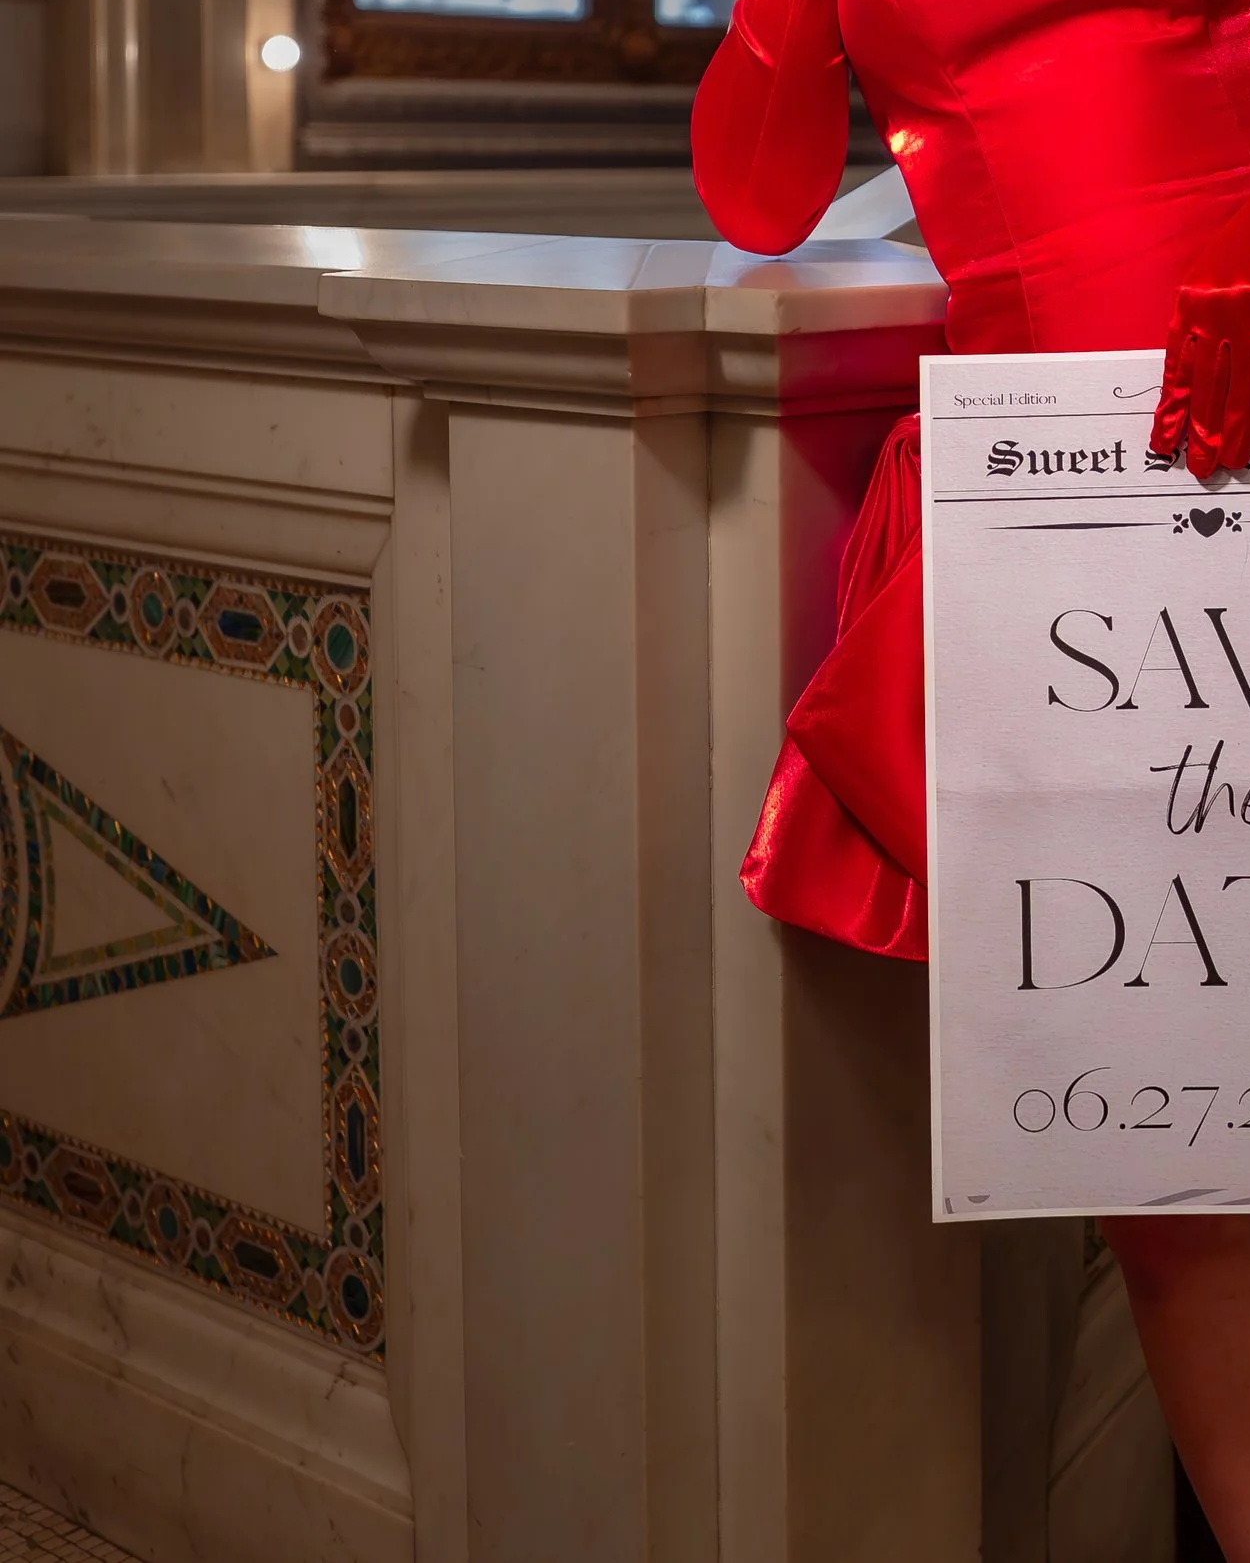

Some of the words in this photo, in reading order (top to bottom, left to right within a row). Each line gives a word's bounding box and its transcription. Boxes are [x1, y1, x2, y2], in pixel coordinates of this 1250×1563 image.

[953, 393, 1004, 409] Special
[1009, 392, 1057, 405] Edition
[986, 439, 1128, 477] Sweet
